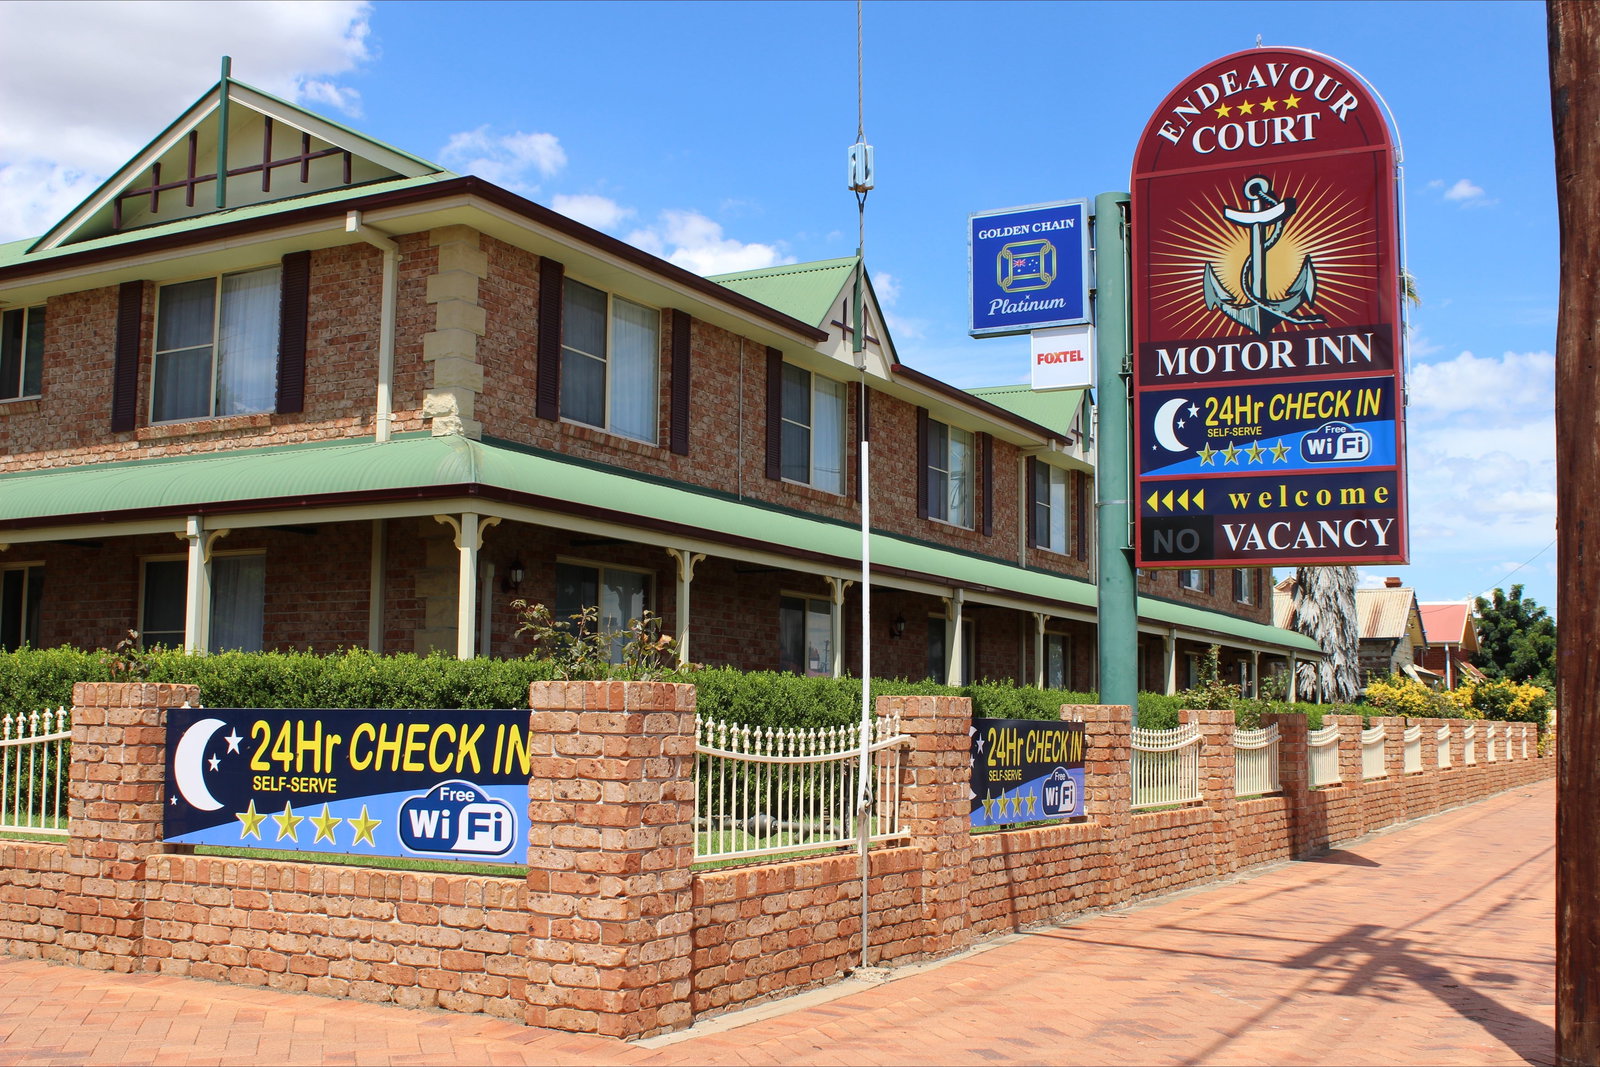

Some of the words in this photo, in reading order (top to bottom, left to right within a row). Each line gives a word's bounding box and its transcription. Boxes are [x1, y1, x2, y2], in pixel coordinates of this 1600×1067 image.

[1157, 63, 1359, 146] ENDEAVOUR
[1192, 112, 1321, 154] COURT
[978, 224, 1030, 240] GOLDEN
[1032, 218, 1075, 233] CHAIN
[987, 297, 1067, 316] Platinum
[1037, 349, 1084, 365] FOXTEL
[1155, 340, 1297, 377] MOTOR
[1304, 332, 1374, 366] INN
[1204, 394, 1264, 427] 24Hr
[1268, 390, 1351, 421] CHECK
[1355, 387, 1382, 417] IN
[1207, 426, 1262, 438] SELF-SERVE
[1325, 425, 1346, 434] Free
[1228, 485, 1389, 510] welcome
[1153, 528, 1200, 554] NO
[1221, 518, 1395, 551] VACANCY
[250, 719, 342, 774] 24Hr
[349, 722, 486, 774] CHECK
[492, 723, 532, 775] IN
[987, 727, 1024, 767] 24Hr
[1025, 729, 1069, 764] CHECK
[1070, 730, 1083, 763] IN
[252, 775, 337, 794] SELF-SERVE
[988, 769, 1022, 781] SELF-SERVE
[1054, 771, 1066, 781] Free
[439, 786, 475, 802] Free
